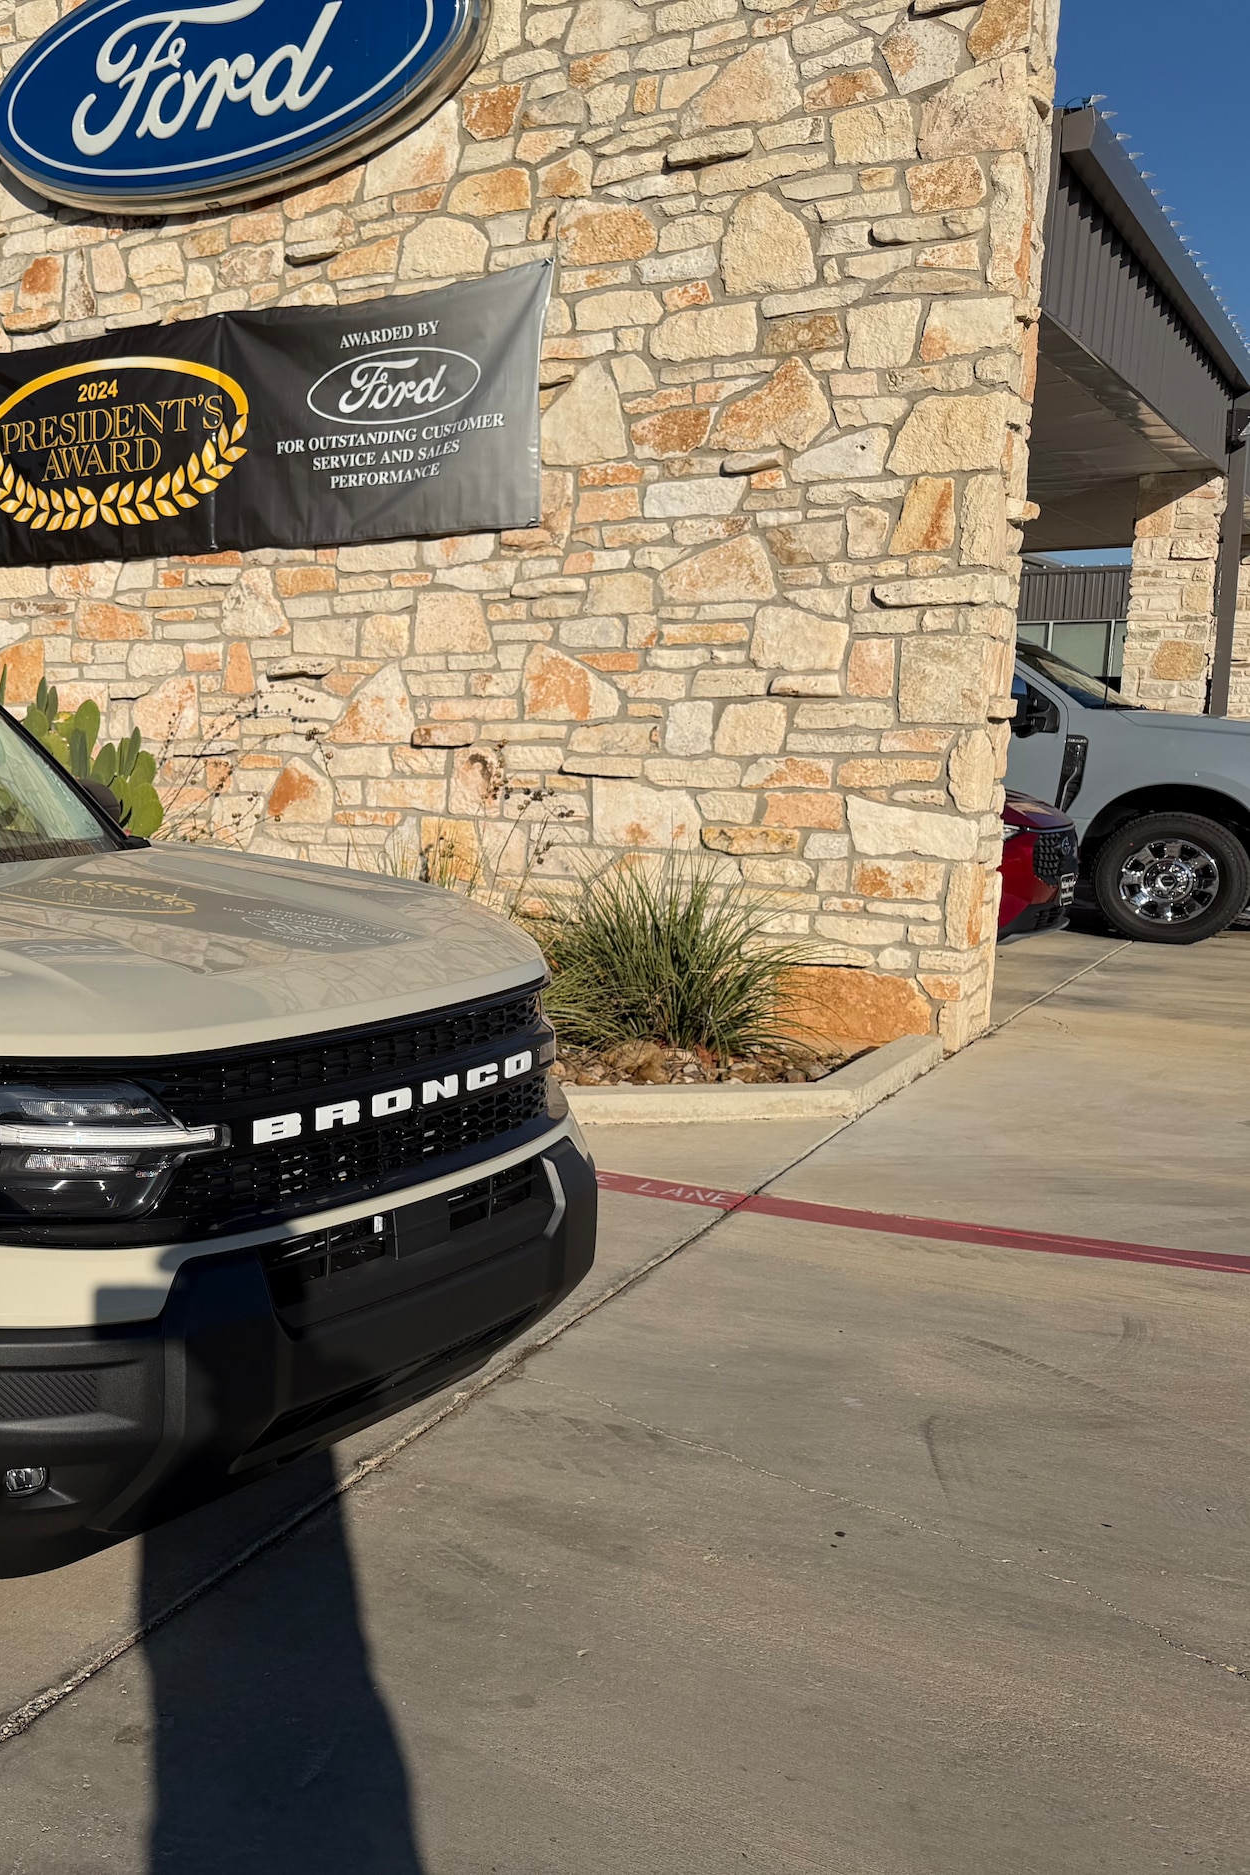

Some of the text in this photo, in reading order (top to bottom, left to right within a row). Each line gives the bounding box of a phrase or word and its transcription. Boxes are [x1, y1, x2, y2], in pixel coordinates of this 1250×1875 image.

[71, 0, 344, 156] Ford
[339, 320, 440, 349] AWARDED BY
[77, 379, 119, 403] 2024
[338, 357, 447, 414] Ford
[0, 394, 224, 455] PRESIDENT'S
[276, 413, 505, 454] FOR OUTSTANDING CUSTOMER
[41, 437, 162, 482] AWARD
[312, 439, 460, 471] SERVICE AND SALES
[330, 462, 440, 489] PERFORMANCE
[252, 1050, 533, 1145] BRONCO
[636, 1182, 739, 1206] LANE
